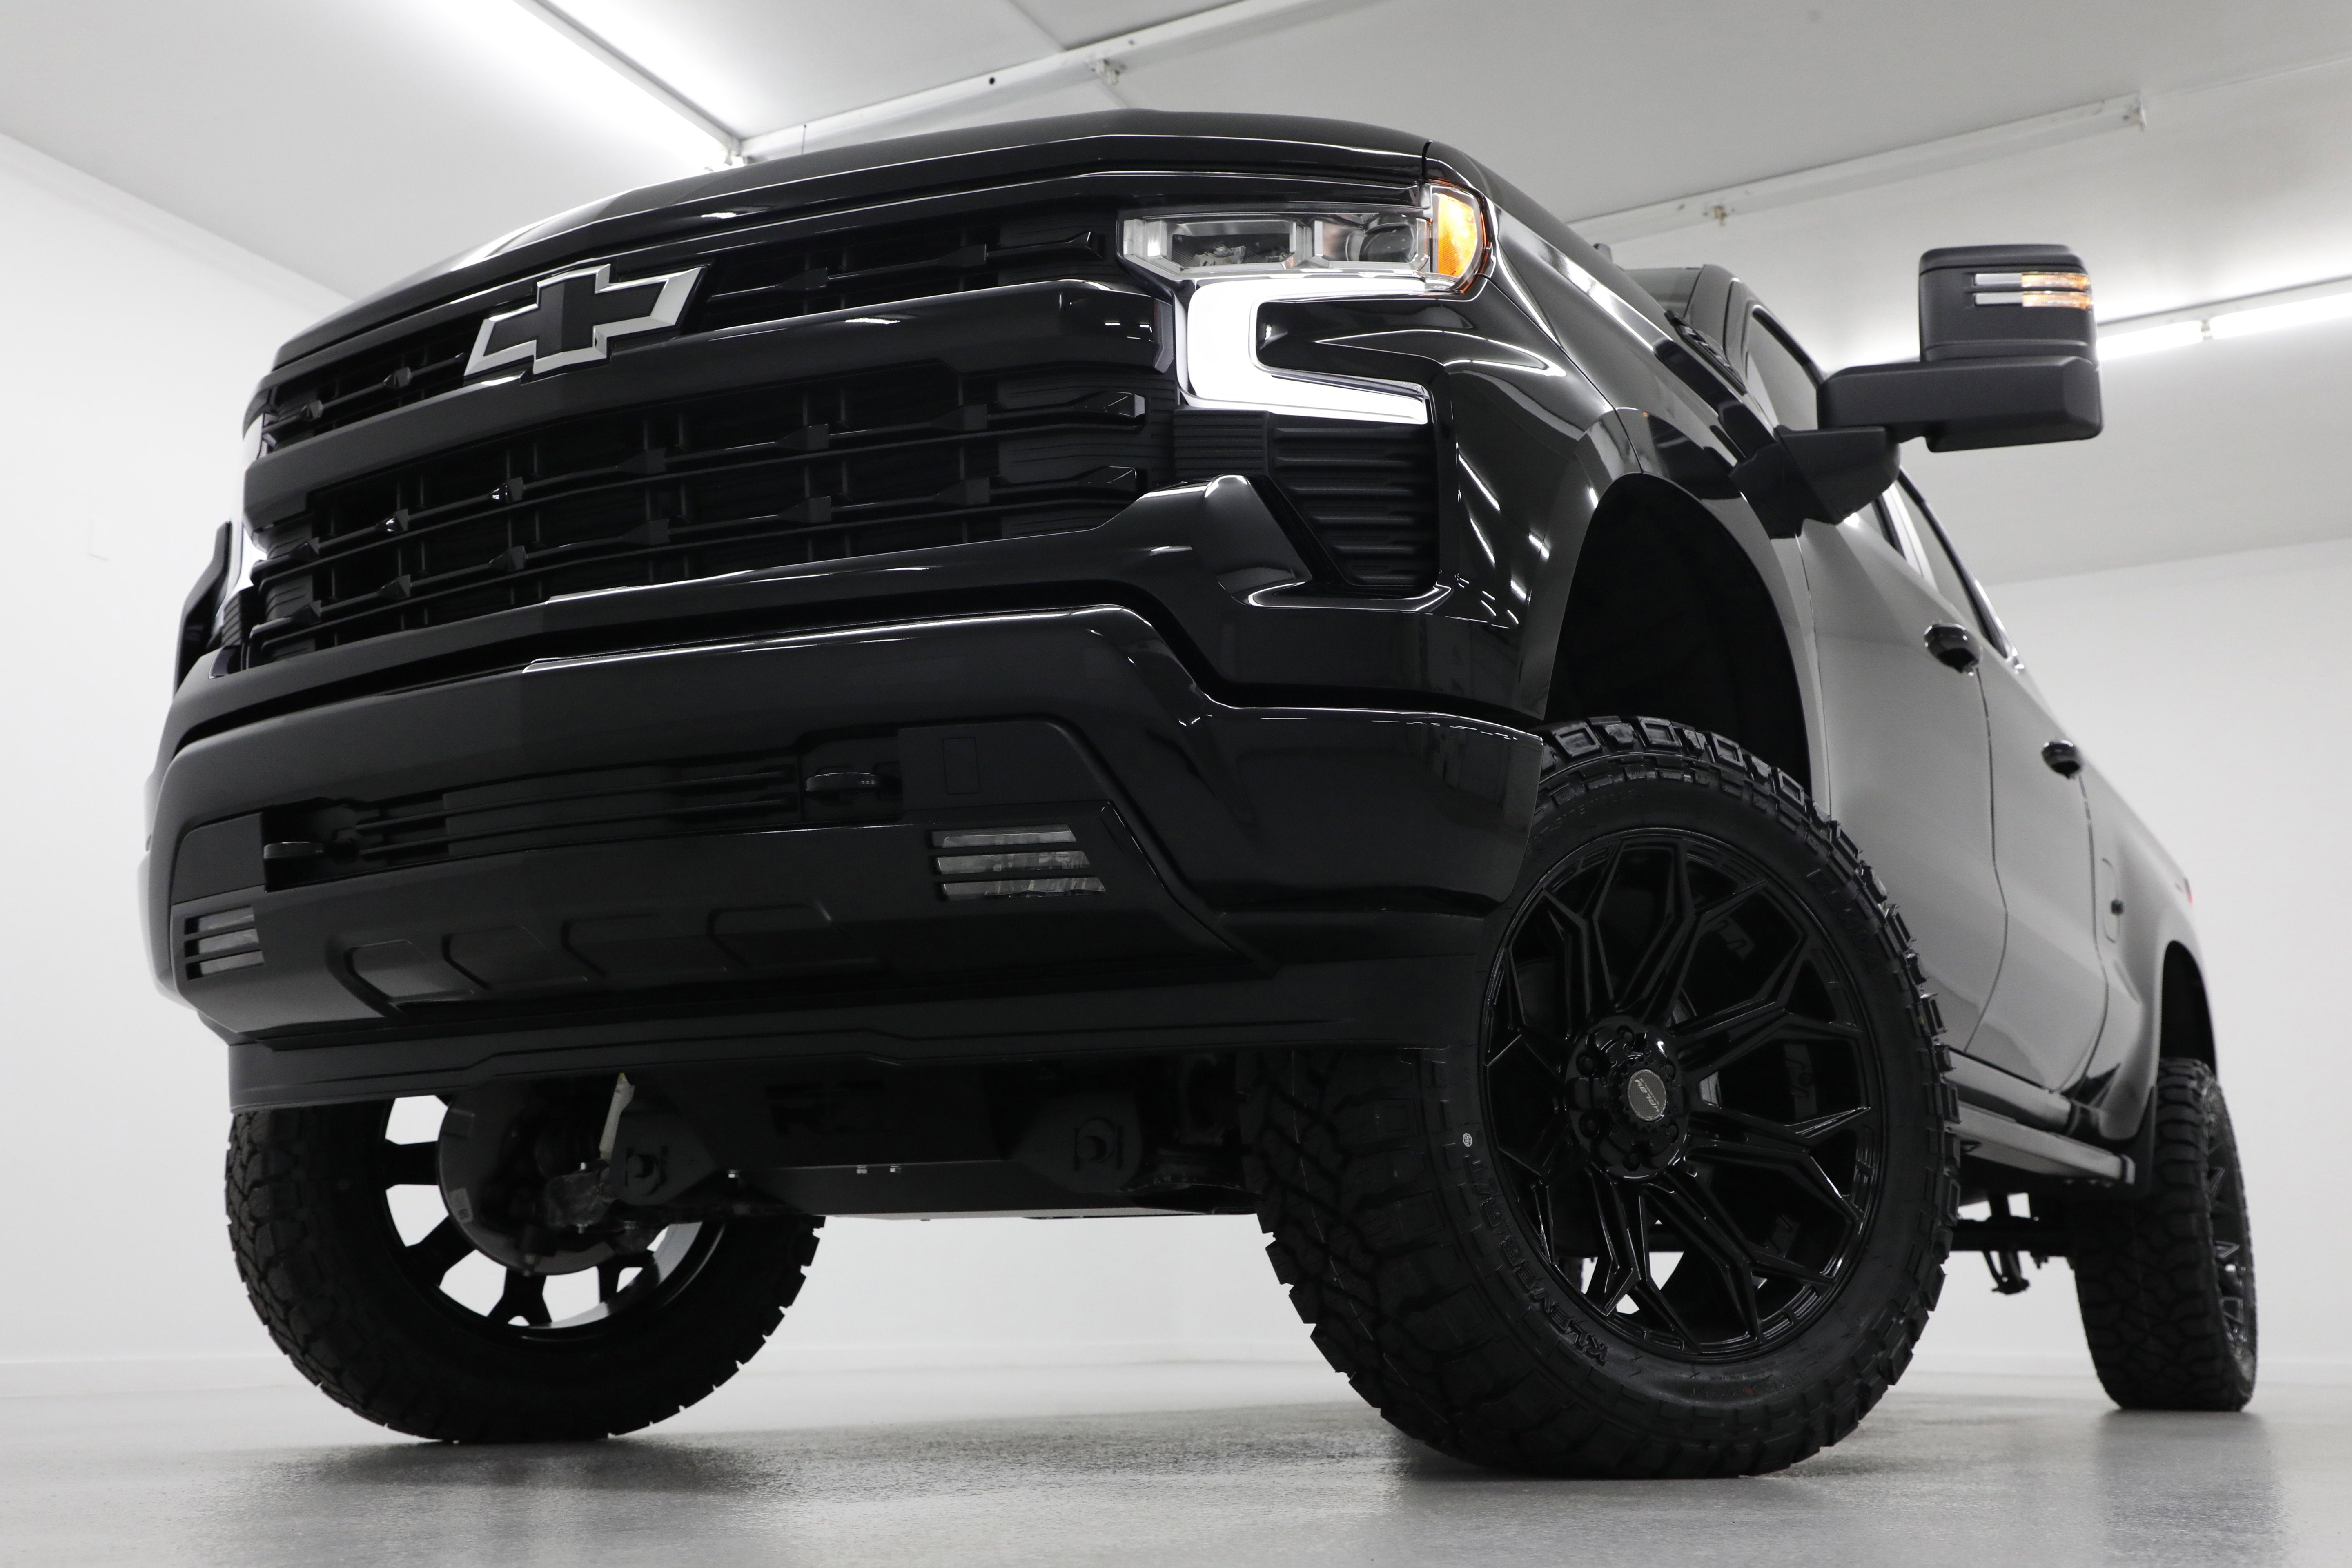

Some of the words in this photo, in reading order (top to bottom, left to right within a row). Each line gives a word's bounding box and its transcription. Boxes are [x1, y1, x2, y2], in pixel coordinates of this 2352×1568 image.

[1635, 1080, 1659, 1112] 4PLAY
[1463, 1154, 1503, 1230] R/T
[1501, 1235, 1608, 1365] KLEVER
